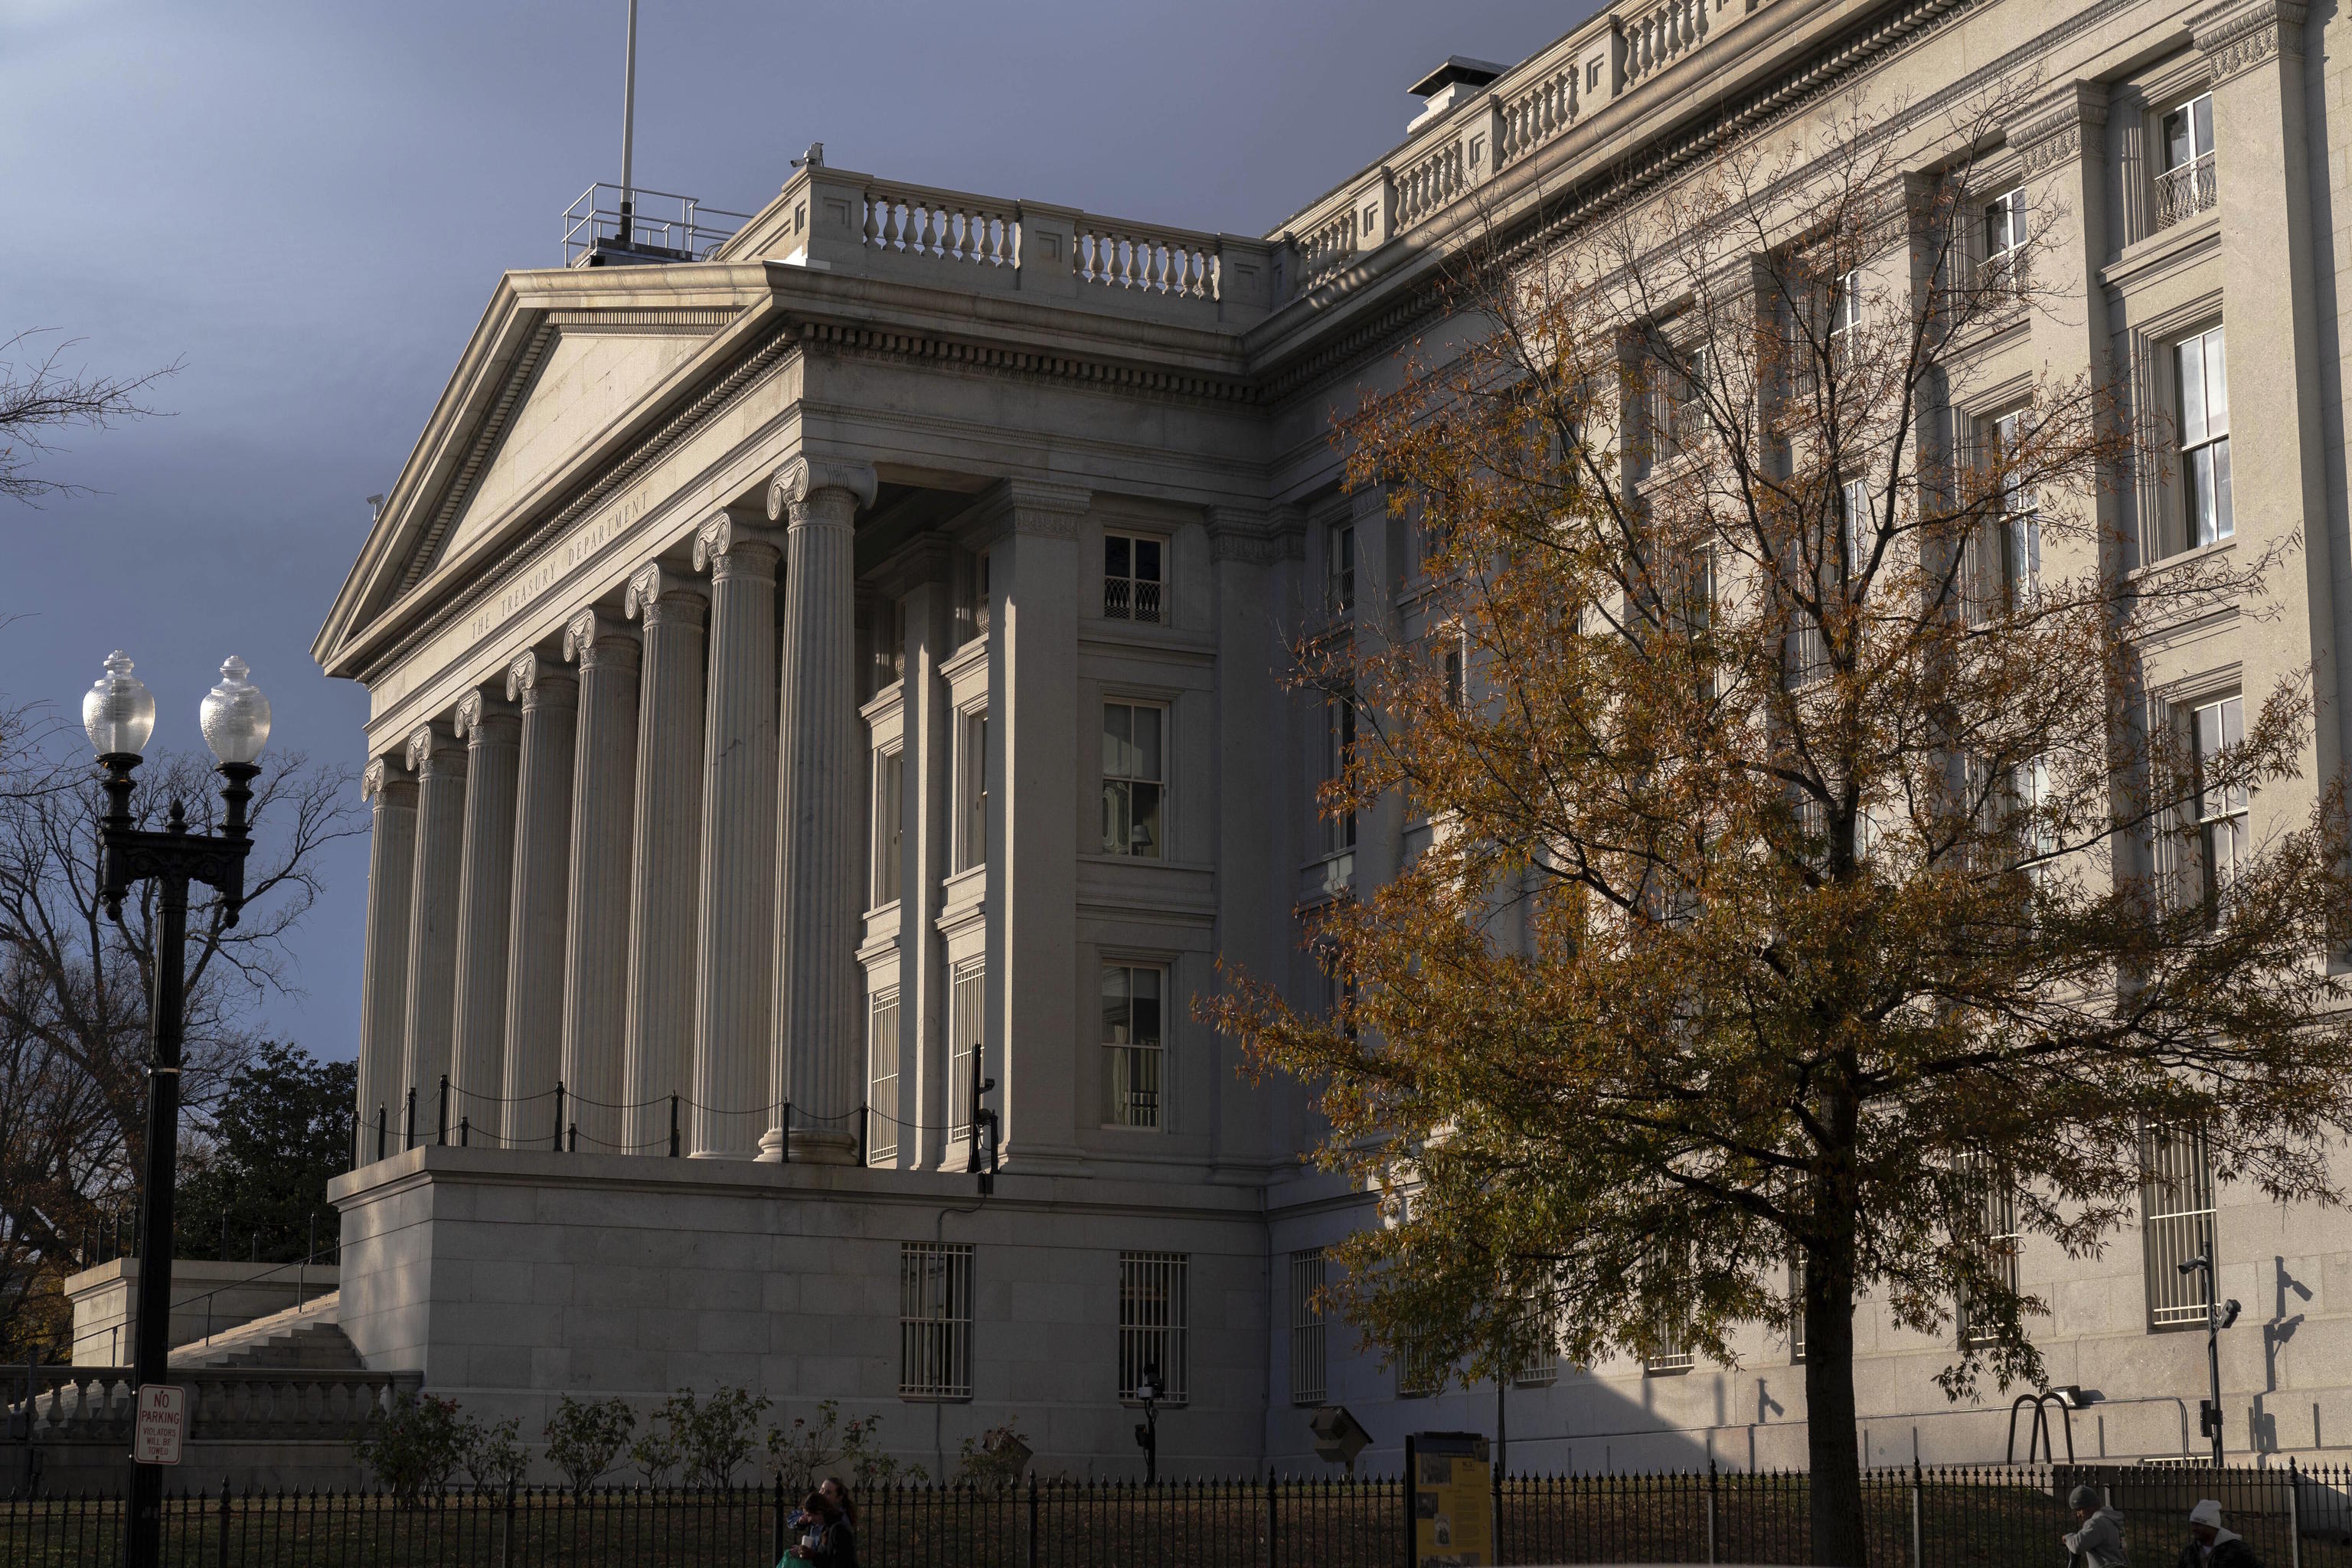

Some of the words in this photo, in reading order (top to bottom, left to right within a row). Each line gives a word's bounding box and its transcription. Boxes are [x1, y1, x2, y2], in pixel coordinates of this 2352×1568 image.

[472, 612, 490, 639] THE
[501, 561, 556, 617] TREASURY
[568, 491, 648, 567] DEPARTMENT
[154, 1393, 169, 1408] NO
[141, 1410, 180, 1425] PARKING
[143, 1427, 176, 1437] VIOLATORS
[146, 1437, 159, 1446] WILL
[163, 1438, 171, 1446] BE
[149, 1446, 168, 1455] TOWED
